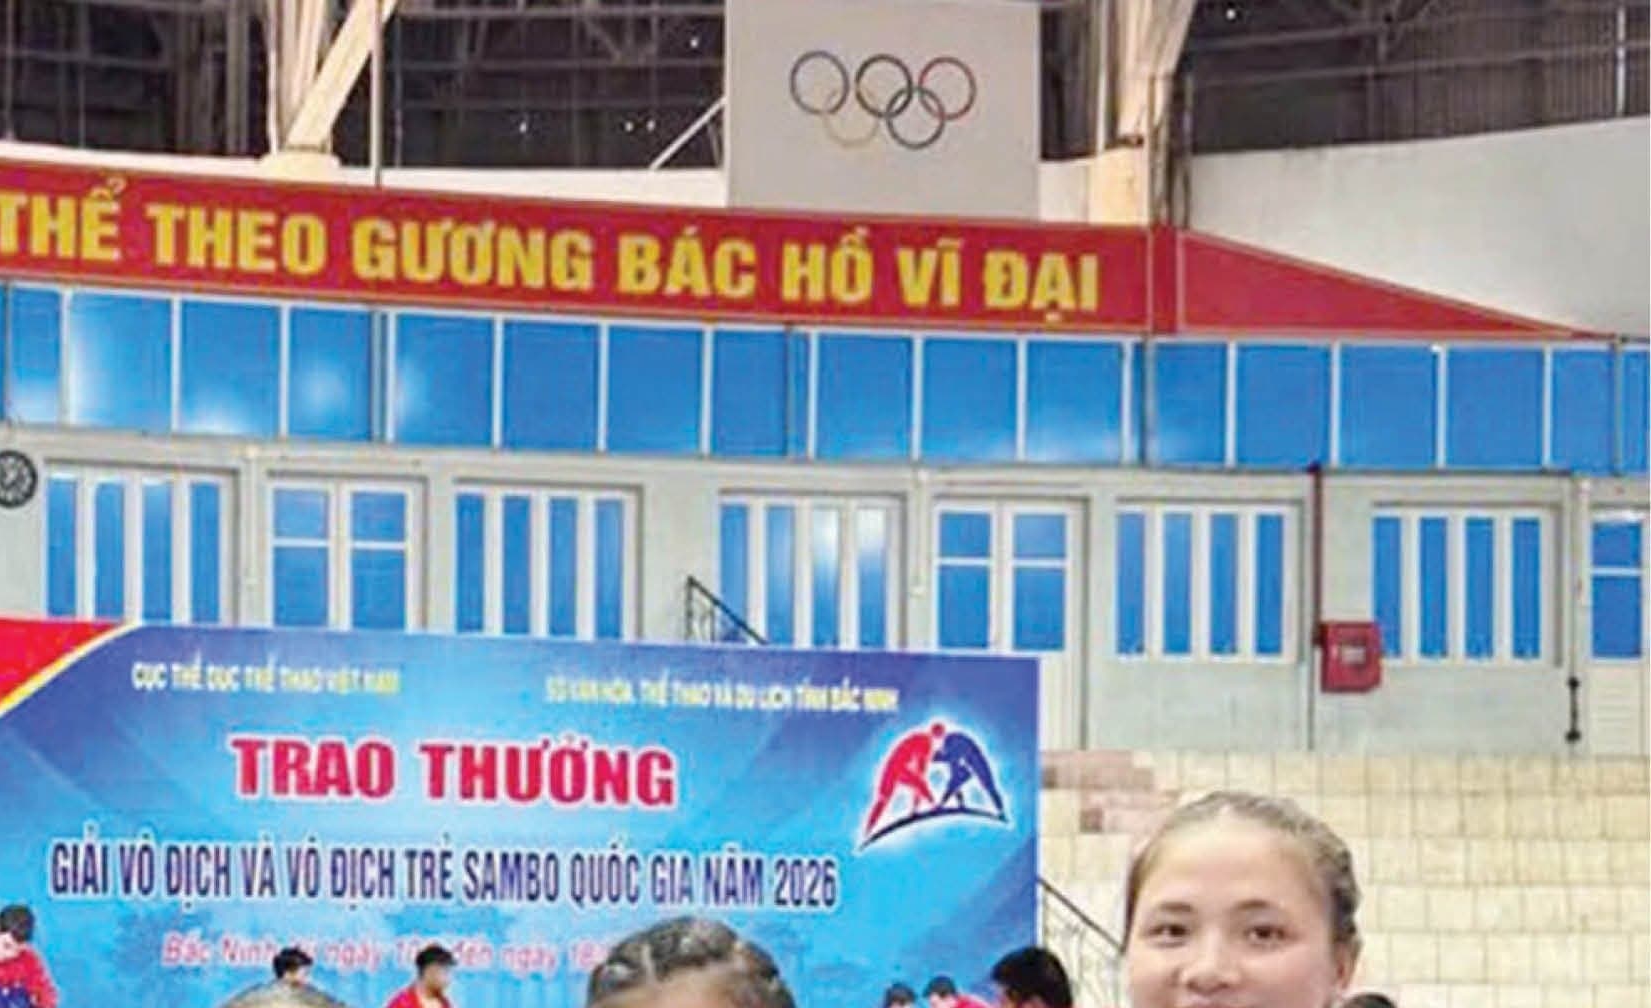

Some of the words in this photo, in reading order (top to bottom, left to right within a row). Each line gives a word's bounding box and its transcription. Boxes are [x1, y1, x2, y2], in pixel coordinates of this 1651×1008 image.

[145, 203, 327, 276] THEO
[354, 217, 595, 292] GƯƠNG
[617, 220, 757, 300] BÁC
[781, 226, 874, 304] HỒ
[897, 236, 961, 307] VĨ
[983, 250, 1099, 321] ĐẠI
[231, 738, 395, 798] TRAO
[418, 733, 675, 806] THƯỞNG
[51, 824, 109, 896] GIẢI
[119, 831, 154, 896] VÔ
[164, 842, 231, 909] ĐỊCH
[240, 833, 277, 898] VÀ
[286, 834, 321, 898] VÔ
[329, 846, 395, 911] ĐỊCH
[404, 832, 453, 899] TRẺ
[462, 849, 560, 902] SAMBO
[569, 837, 641, 908] QUỐC
[651, 855, 694, 905] GIA
[702, 846, 765, 906] NĂM
[773, 857, 838, 907] 2026
